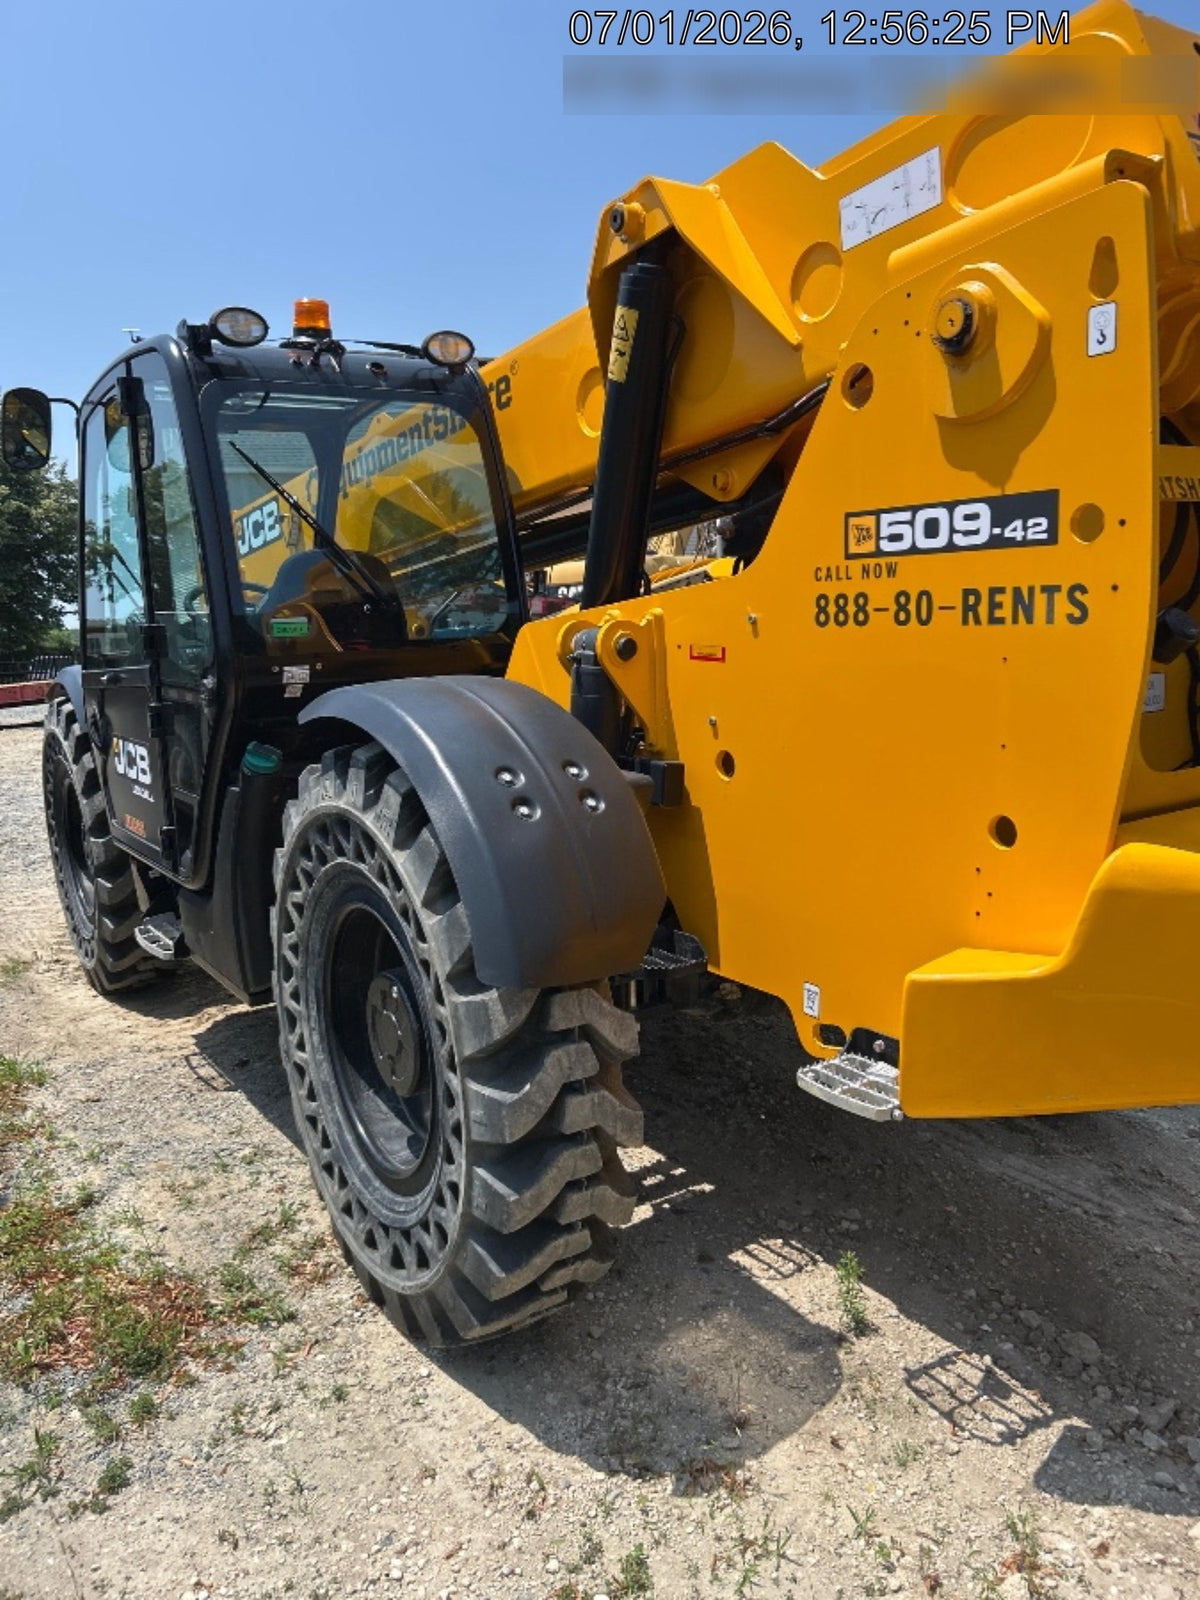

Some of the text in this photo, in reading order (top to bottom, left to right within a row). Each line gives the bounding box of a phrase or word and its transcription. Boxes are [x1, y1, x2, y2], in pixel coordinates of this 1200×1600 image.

[238, 500, 281, 556] JCB
[879, 502, 1049, 552] 509-42
[815, 561, 899, 582] CALL NOW
[814, 582, 1090, 628] 888-80-RENTS
[114, 737, 152, 785] JCB
